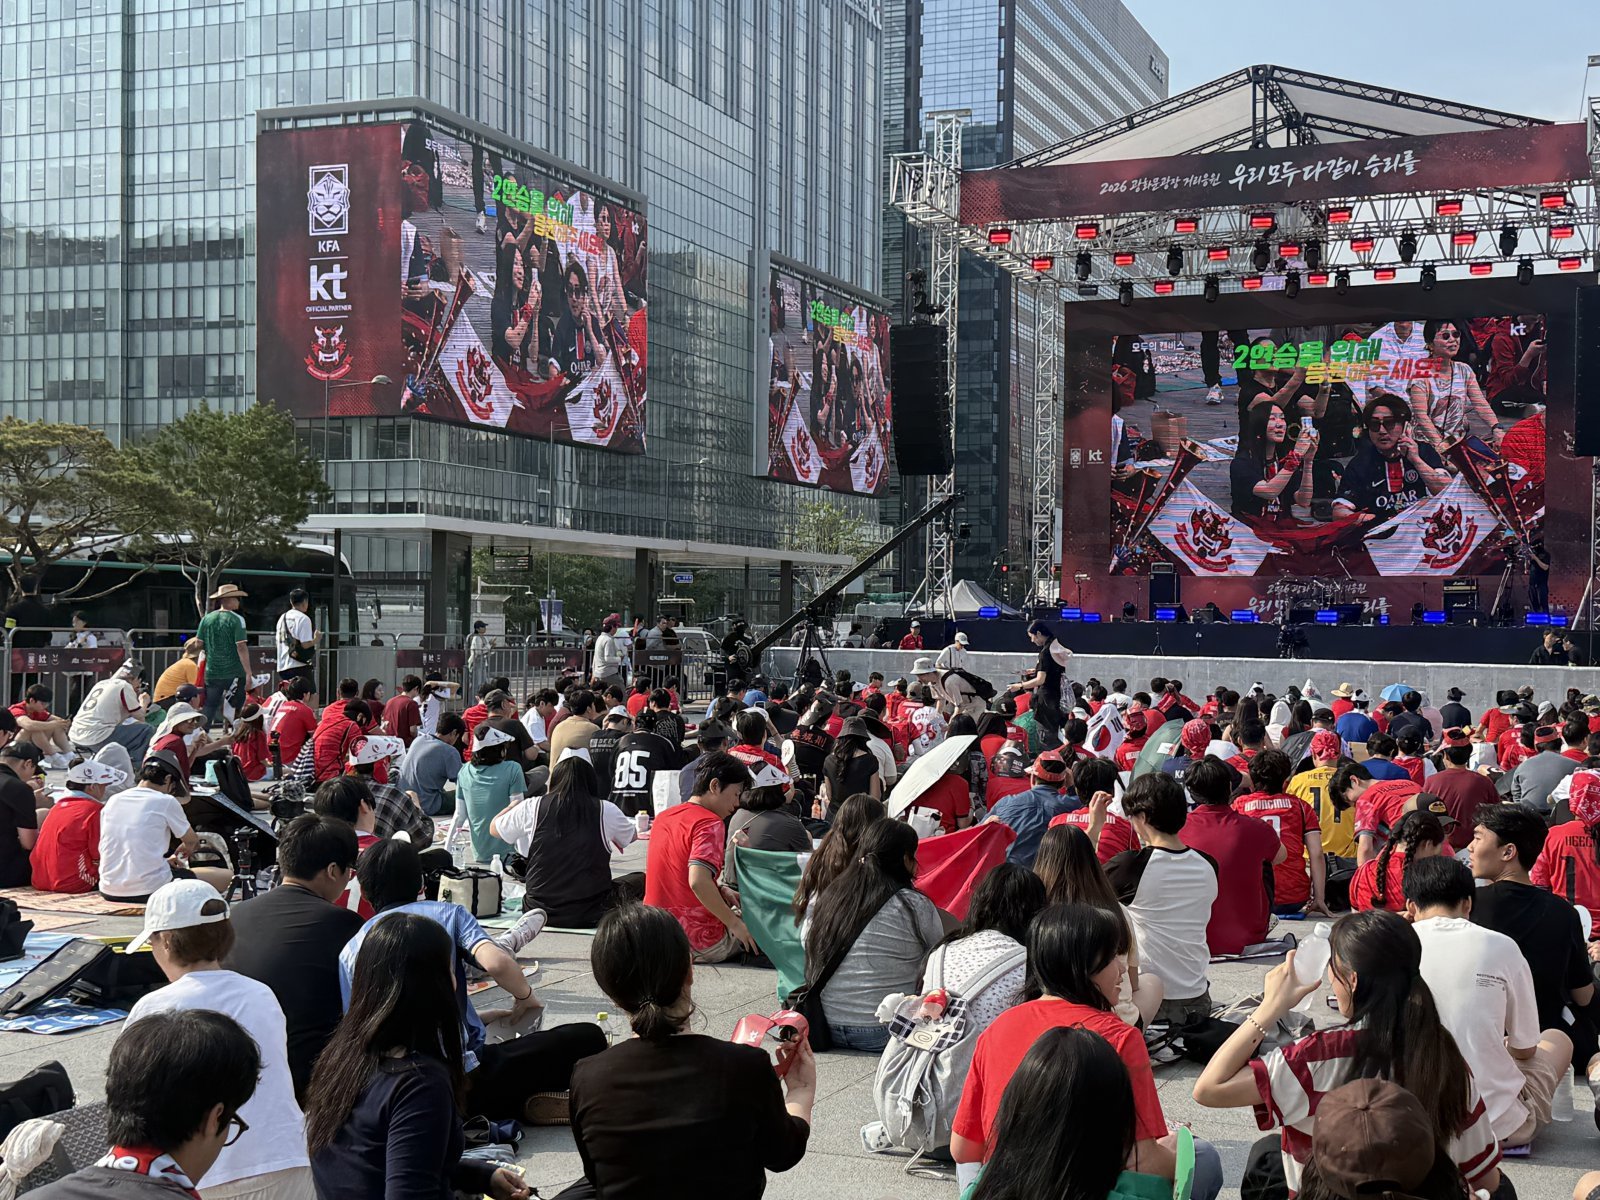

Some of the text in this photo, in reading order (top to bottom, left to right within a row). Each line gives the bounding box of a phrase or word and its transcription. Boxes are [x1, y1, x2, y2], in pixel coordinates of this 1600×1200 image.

[1099, 173, 1221, 195] 2026 광화문광장 거리응원
[1228, 162, 1266, 191] 우리
[491, 175, 574, 228] 2연승을 위해
[318, 240, 341, 253] KFA
[310, 264, 348, 301] kt
[328, 304, 353, 312] PARTNER
[1510, 322, 1527, 336] kt
[1131, 341, 1157, 352] 모두의
[1232, 337, 1383, 370] 2연승을 위해
[1088, 449, 1103, 461] kt
[1376, 490, 1418, 508] QATAR
[614, 750, 651, 789] 85
[1565, 835, 1593, 848] HEEC
